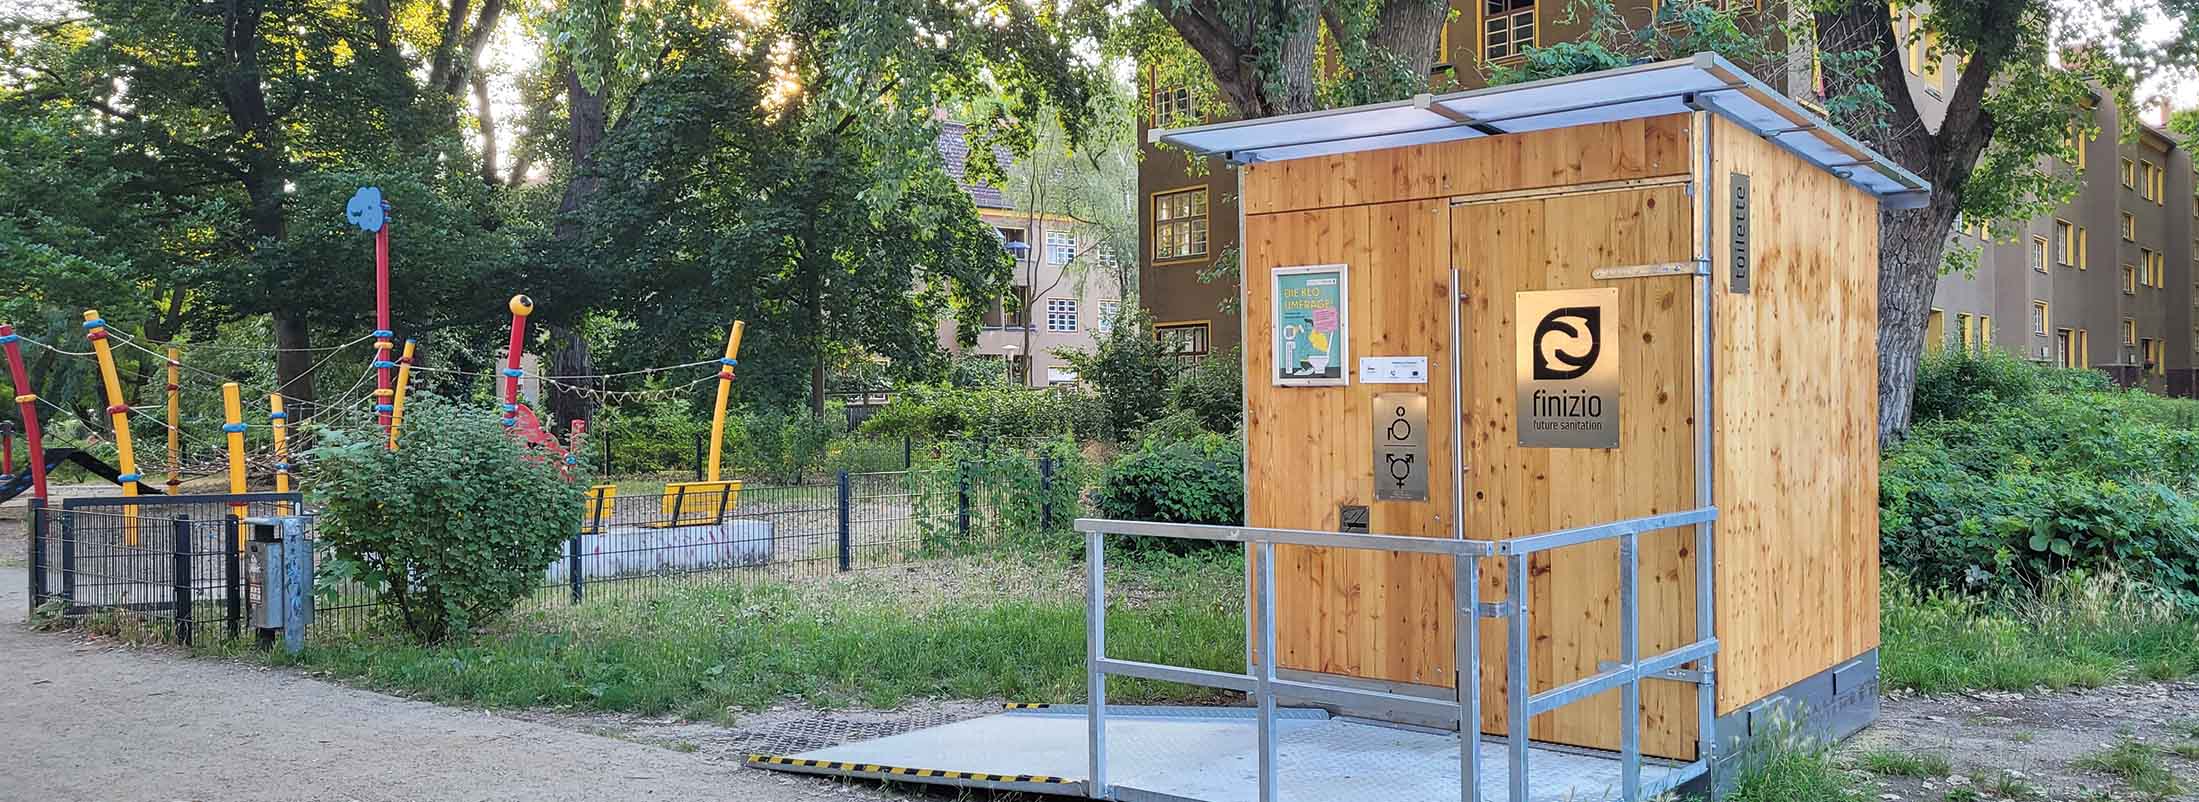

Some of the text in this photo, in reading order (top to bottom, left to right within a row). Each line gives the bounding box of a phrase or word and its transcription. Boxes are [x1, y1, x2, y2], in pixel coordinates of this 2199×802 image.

[1735, 186, 1746, 279] toilette
[1284, 287, 1320, 297] DIE KLO
[1533, 389, 1602, 417] finizio
[1533, 420, 1602, 431] future sanitation
